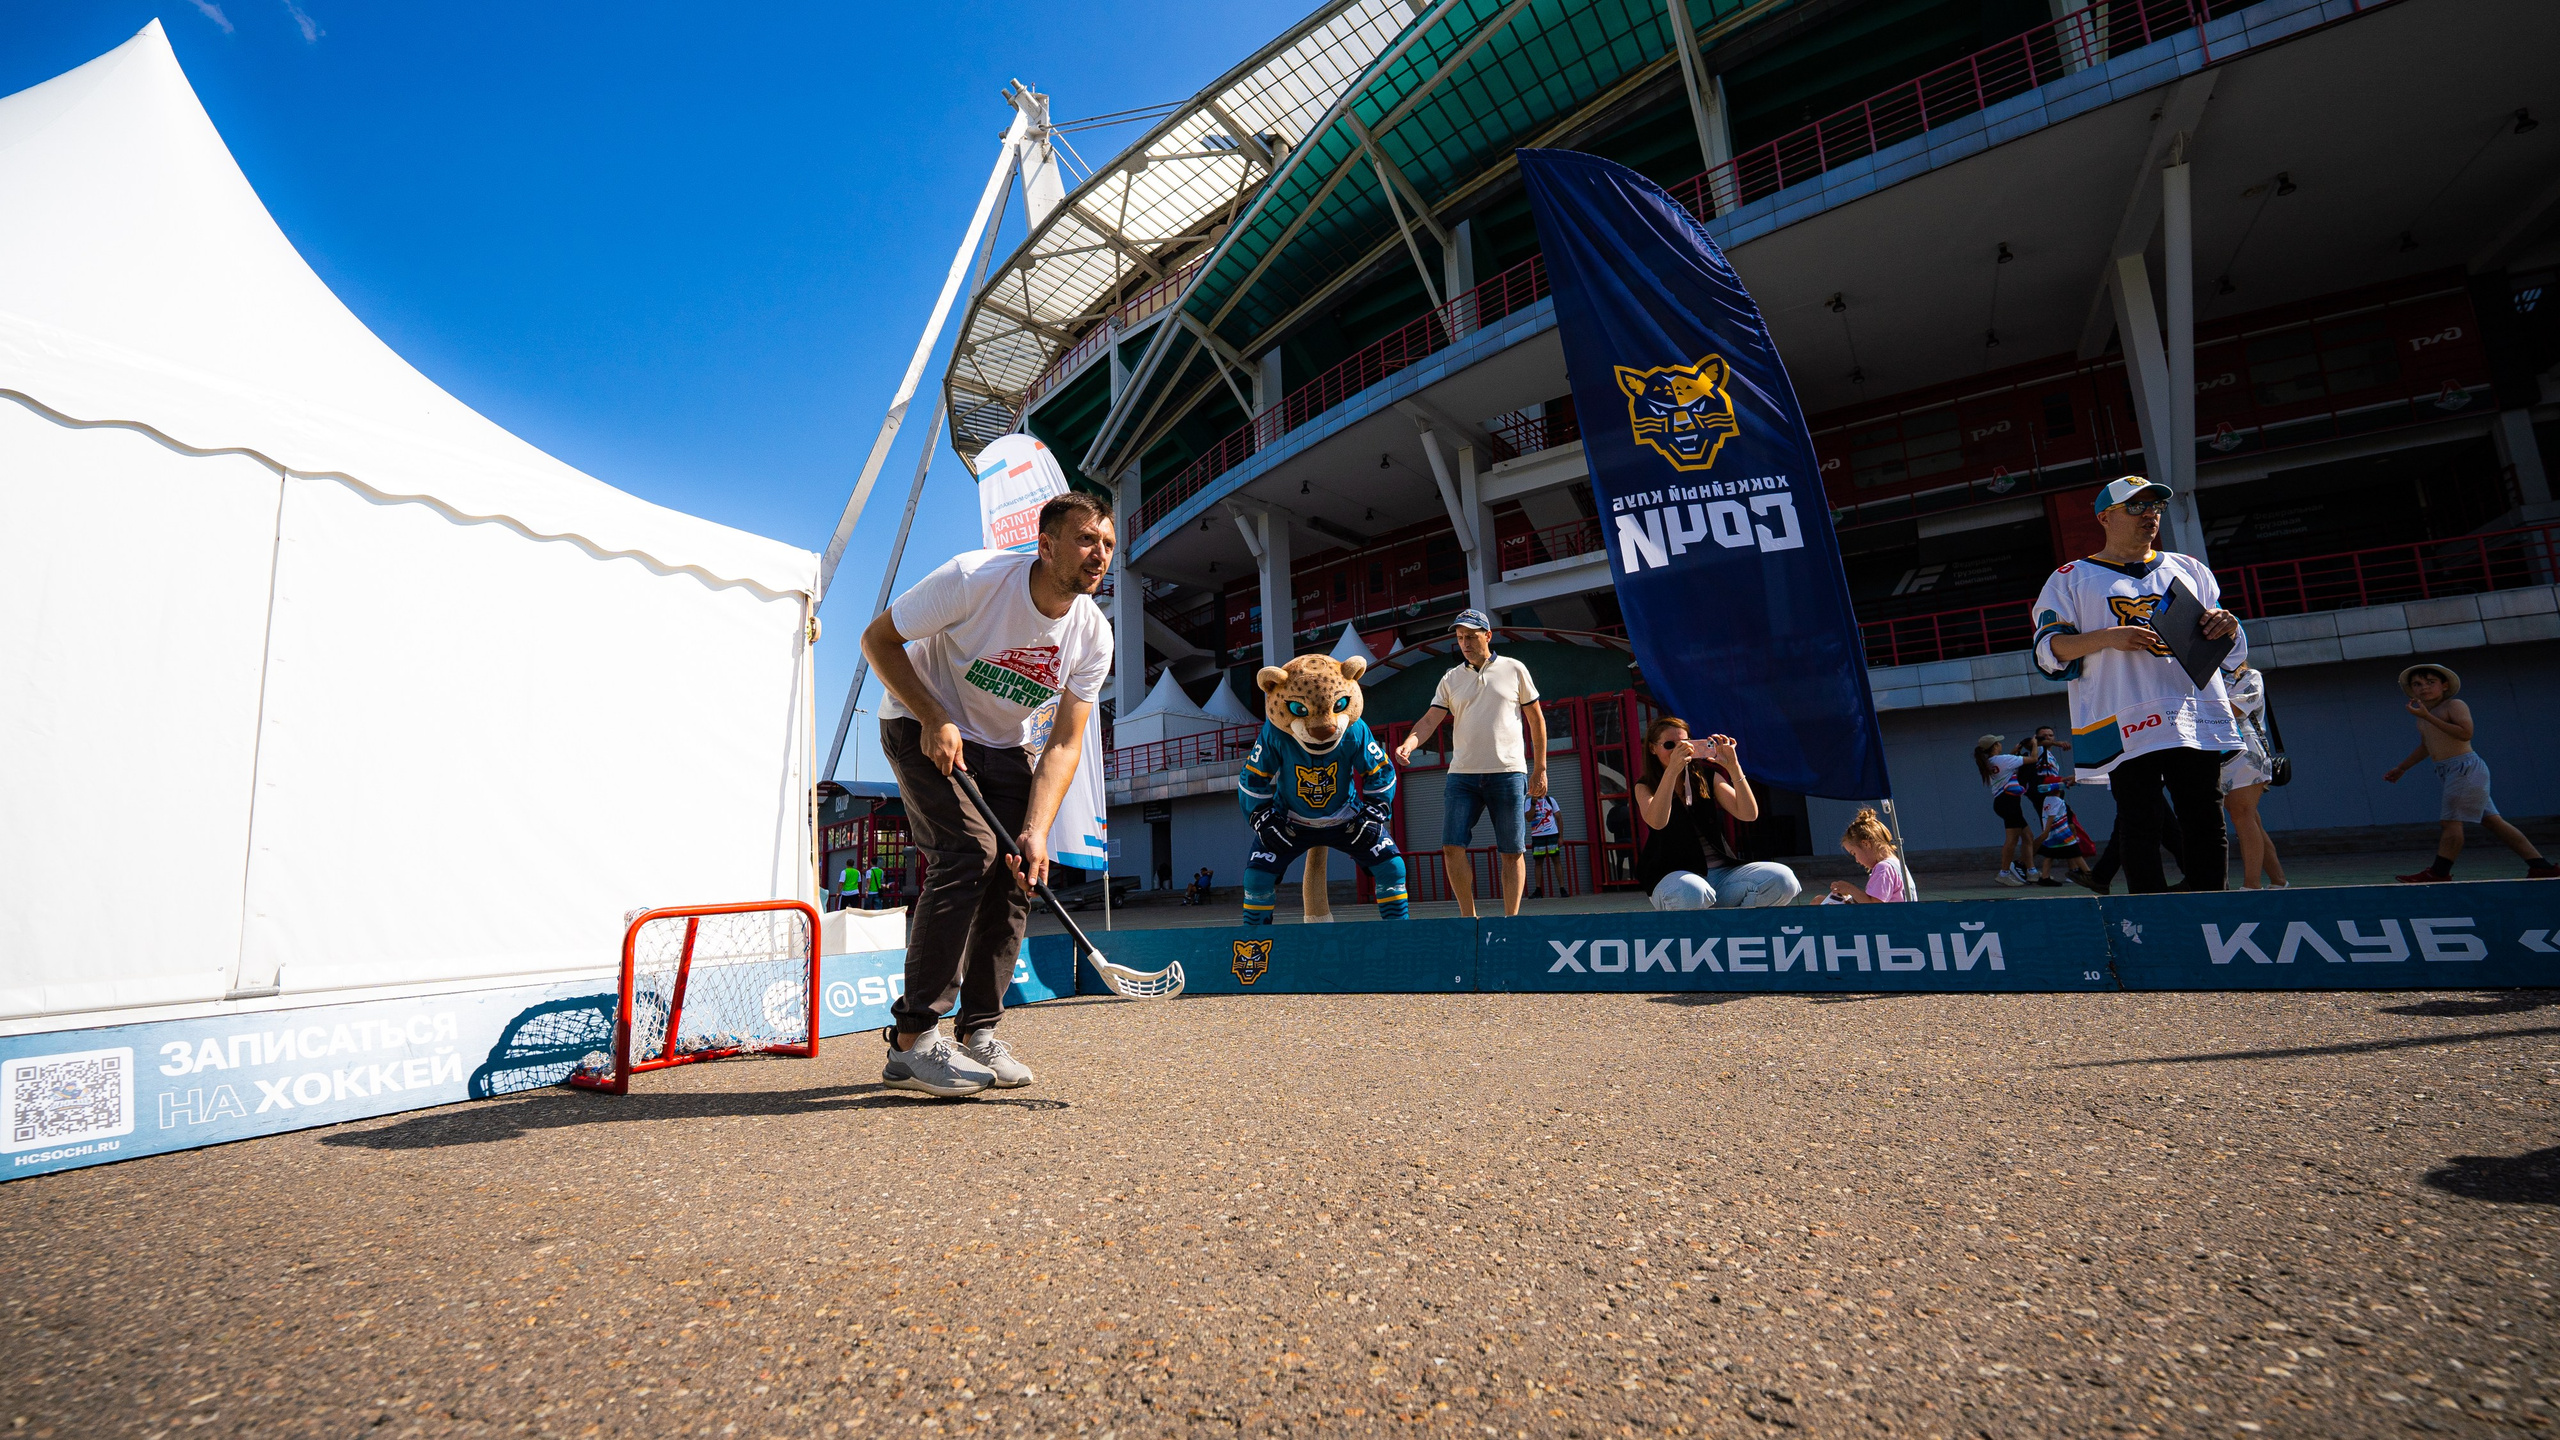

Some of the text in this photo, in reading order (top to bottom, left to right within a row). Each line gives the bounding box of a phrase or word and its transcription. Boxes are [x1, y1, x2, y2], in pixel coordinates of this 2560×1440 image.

[2252, 503, 2325, 520] Федеральная
[2254, 518, 2302, 530] грузовая
[2256, 525, 2309, 539] компания
[1951, 553, 2012, 570] Федеральная
[1952, 567, 1993, 579] грузовая
[1954, 574, 1998, 587] компания
[970, 658, 1001, 680] НАШ
[964, 669, 1009, 700] ВПЕРЕД
[1250, 740, 1263, 763] 3
[1547, 921, 2006, 973] ХОККЕЙНЫЙ
[2201, 917, 2489, 965] КЛУБ
[1455, 975, 1461, 983] 9
[2083, 970, 2100, 982] 10
[159, 1011, 459, 1077] ЗАПИСАТЬСЯ
[159, 1052, 463, 1130] НА ХОККЕЙ
[14, 1140, 121, 1167] HCSOCHI.RU
